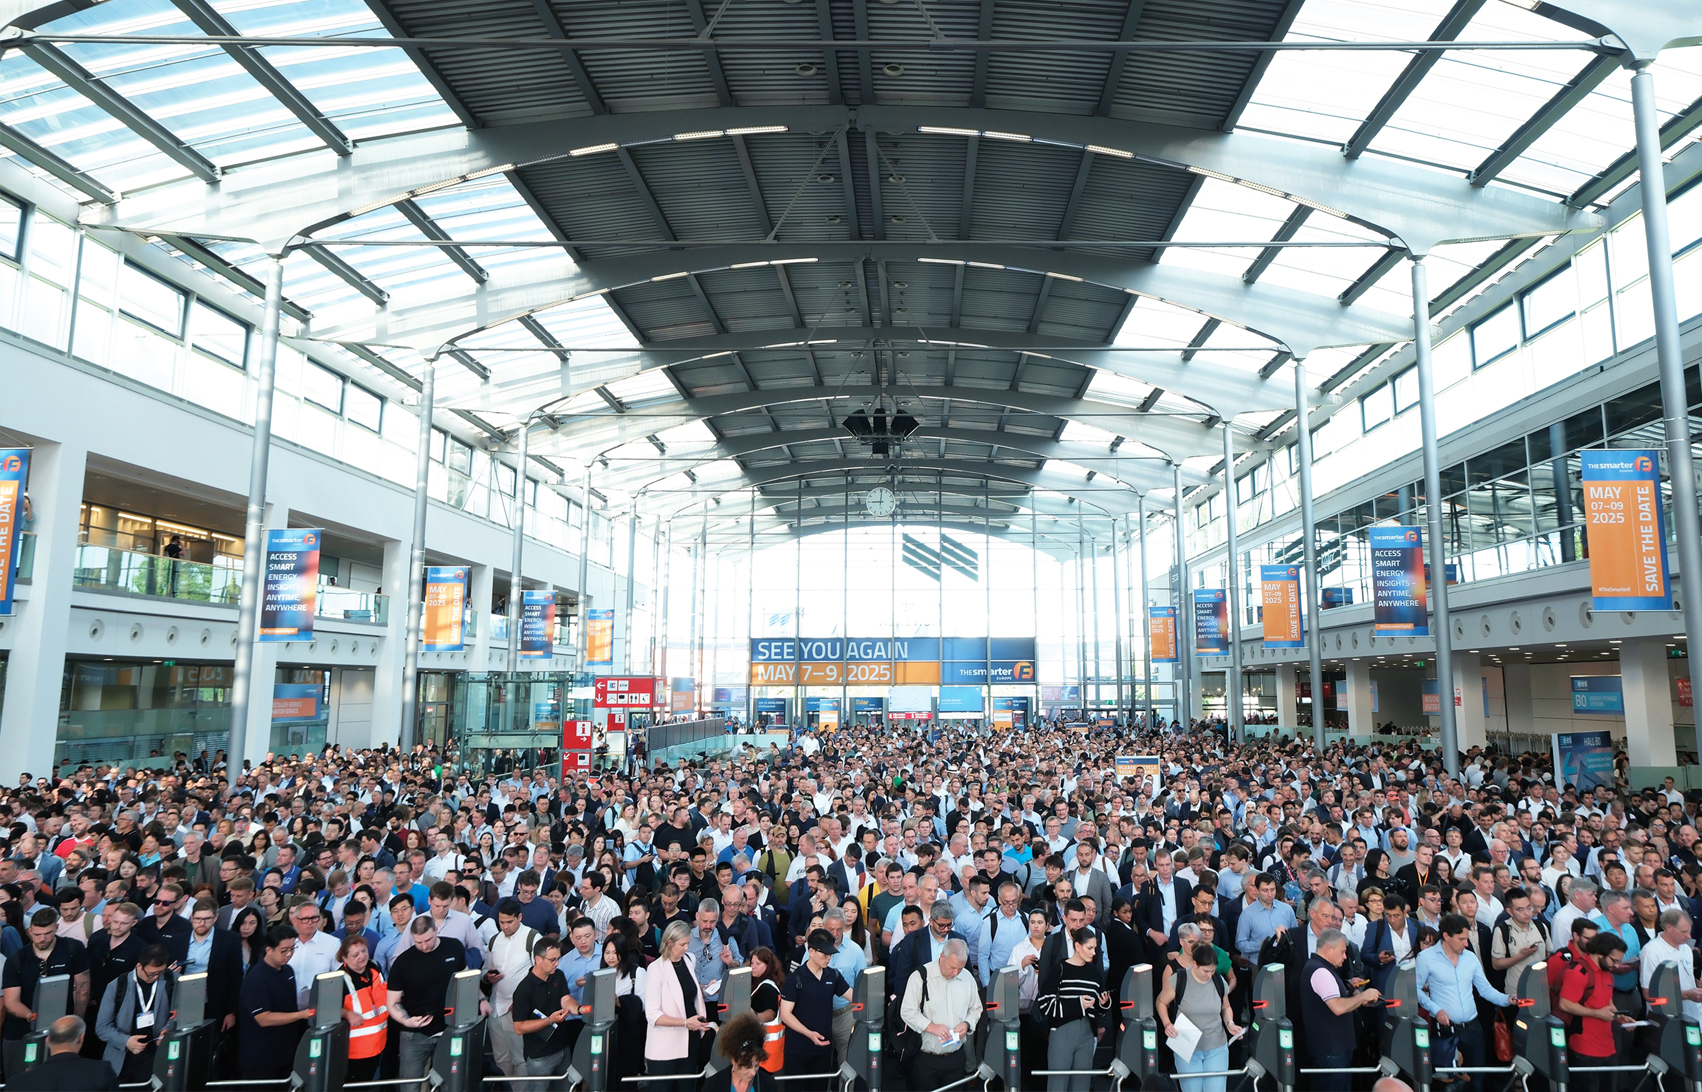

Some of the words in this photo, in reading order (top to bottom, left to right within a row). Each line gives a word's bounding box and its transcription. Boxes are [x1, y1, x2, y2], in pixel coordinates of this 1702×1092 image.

[1590, 486, 1622, 499] MAY
[1590, 502, 1624, 510] 07–09
[1637, 486, 1652, 521] DATE
[1592, 512, 1624, 523] 2025
[1641, 525, 1654, 552] THE
[1643, 556, 1658, 592] SAVE
[758, 642, 794, 659] SEE
[800, 642, 840, 659] YOU
[846, 642, 908, 659] AGAIN
[758, 665, 796, 680] MAY
[802, 665, 843, 683] 7–9,
[848, 665, 890, 680] 2025
[1583, 737, 1595, 746] HALL
